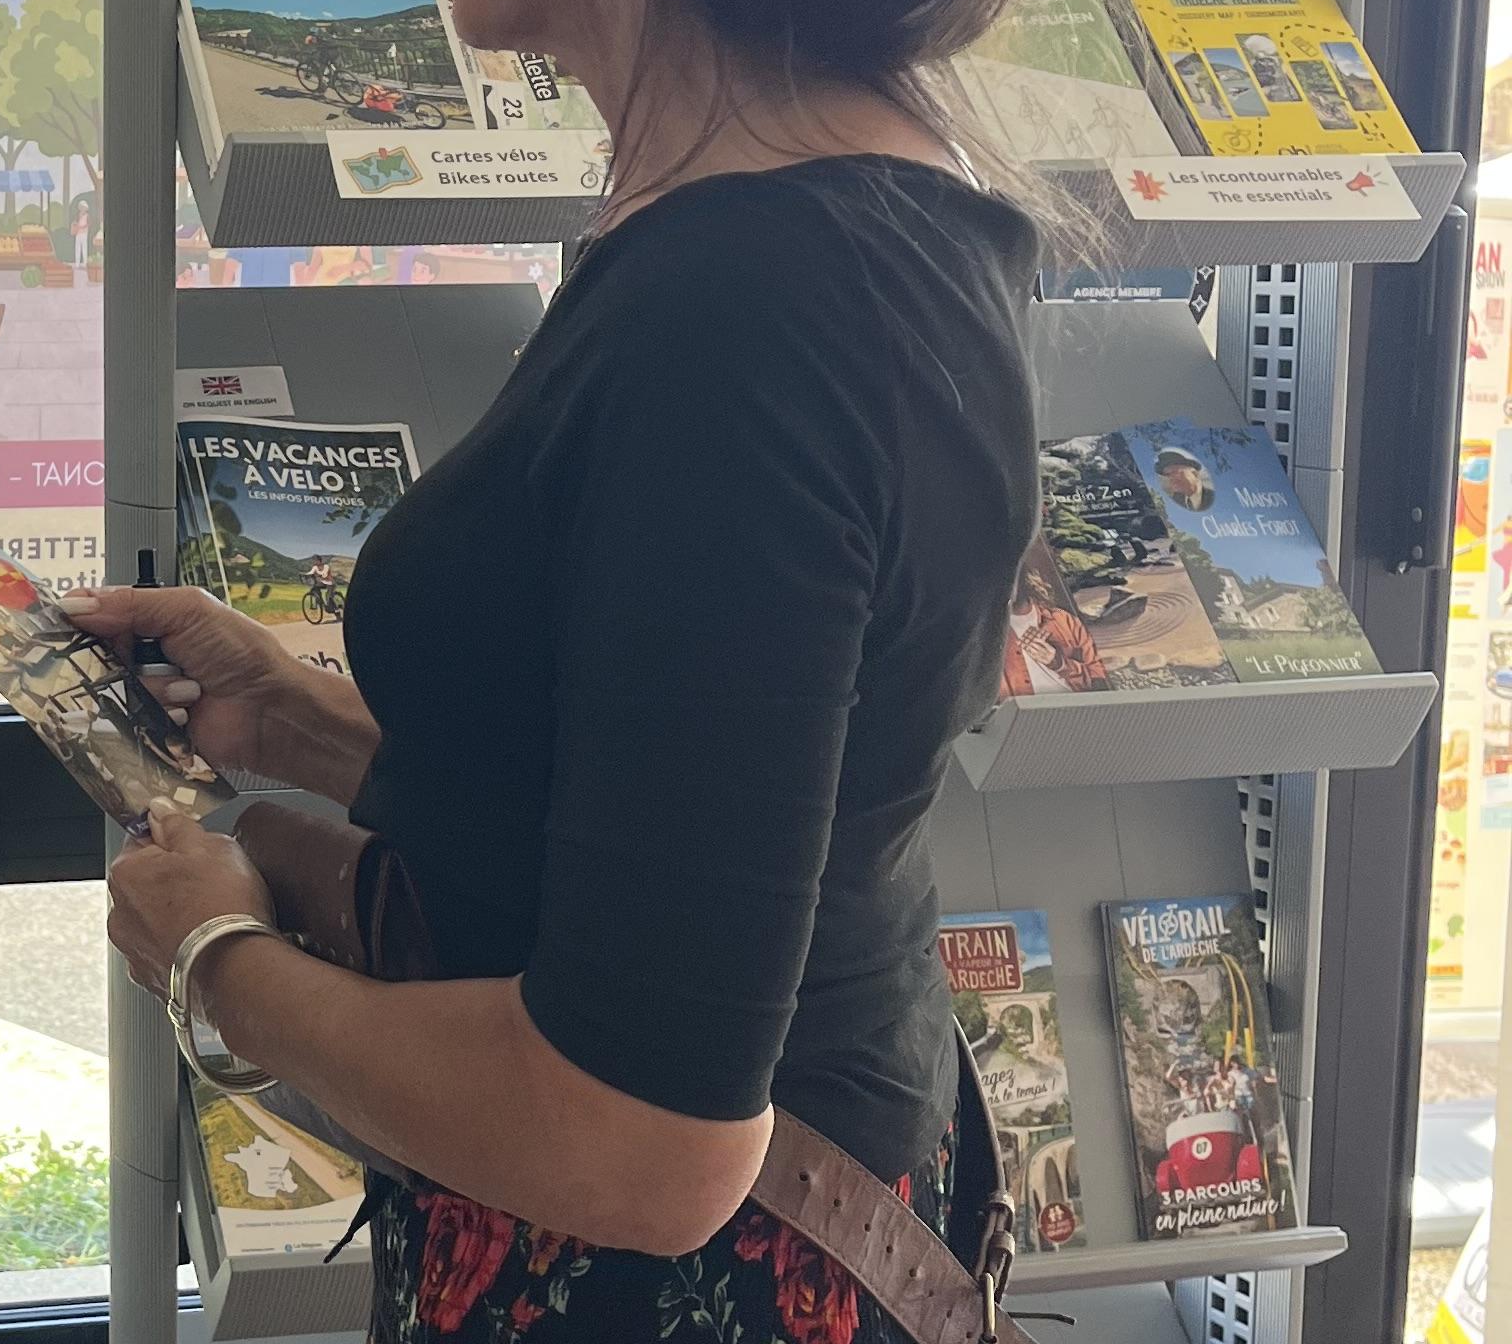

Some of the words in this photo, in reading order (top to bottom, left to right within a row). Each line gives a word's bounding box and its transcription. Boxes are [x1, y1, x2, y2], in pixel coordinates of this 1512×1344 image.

[502, 98, 524, 120] 23
[431, 150, 493, 163] Cartes
[497, 148, 548, 163] vélos
[438, 170, 491, 184] Bikes
[495, 171, 559, 184] routes
[1169, 169, 1197, 184] Les
[1200, 168, 1343, 184] incontournables
[1208, 189, 1242, 203] The
[1246, 188, 1333, 202] essentials
[188, 437, 240, 459] LES
[243, 439, 402, 469] VACANCES
[248, 490, 268, 500] LES
[268, 492, 303, 504] INFOS
[304, 494, 365, 508] PRATIQUES
[1049, 489, 1095, 506] Jardin
[1100, 485, 1133, 502] Zen
[939, 929, 1010, 962] TRAIN
[1142, 945, 1161, 964] DE
[1196, 1143, 1209, 1156] 07
[1161, 1189, 1173, 1204] 3
[1175, 1178, 1262, 1204] PARCOURS
[1156, 1211, 1175, 1232] en
[1175, 1201, 1226, 1238] pleine
[1228, 1194, 1278, 1220] nature
